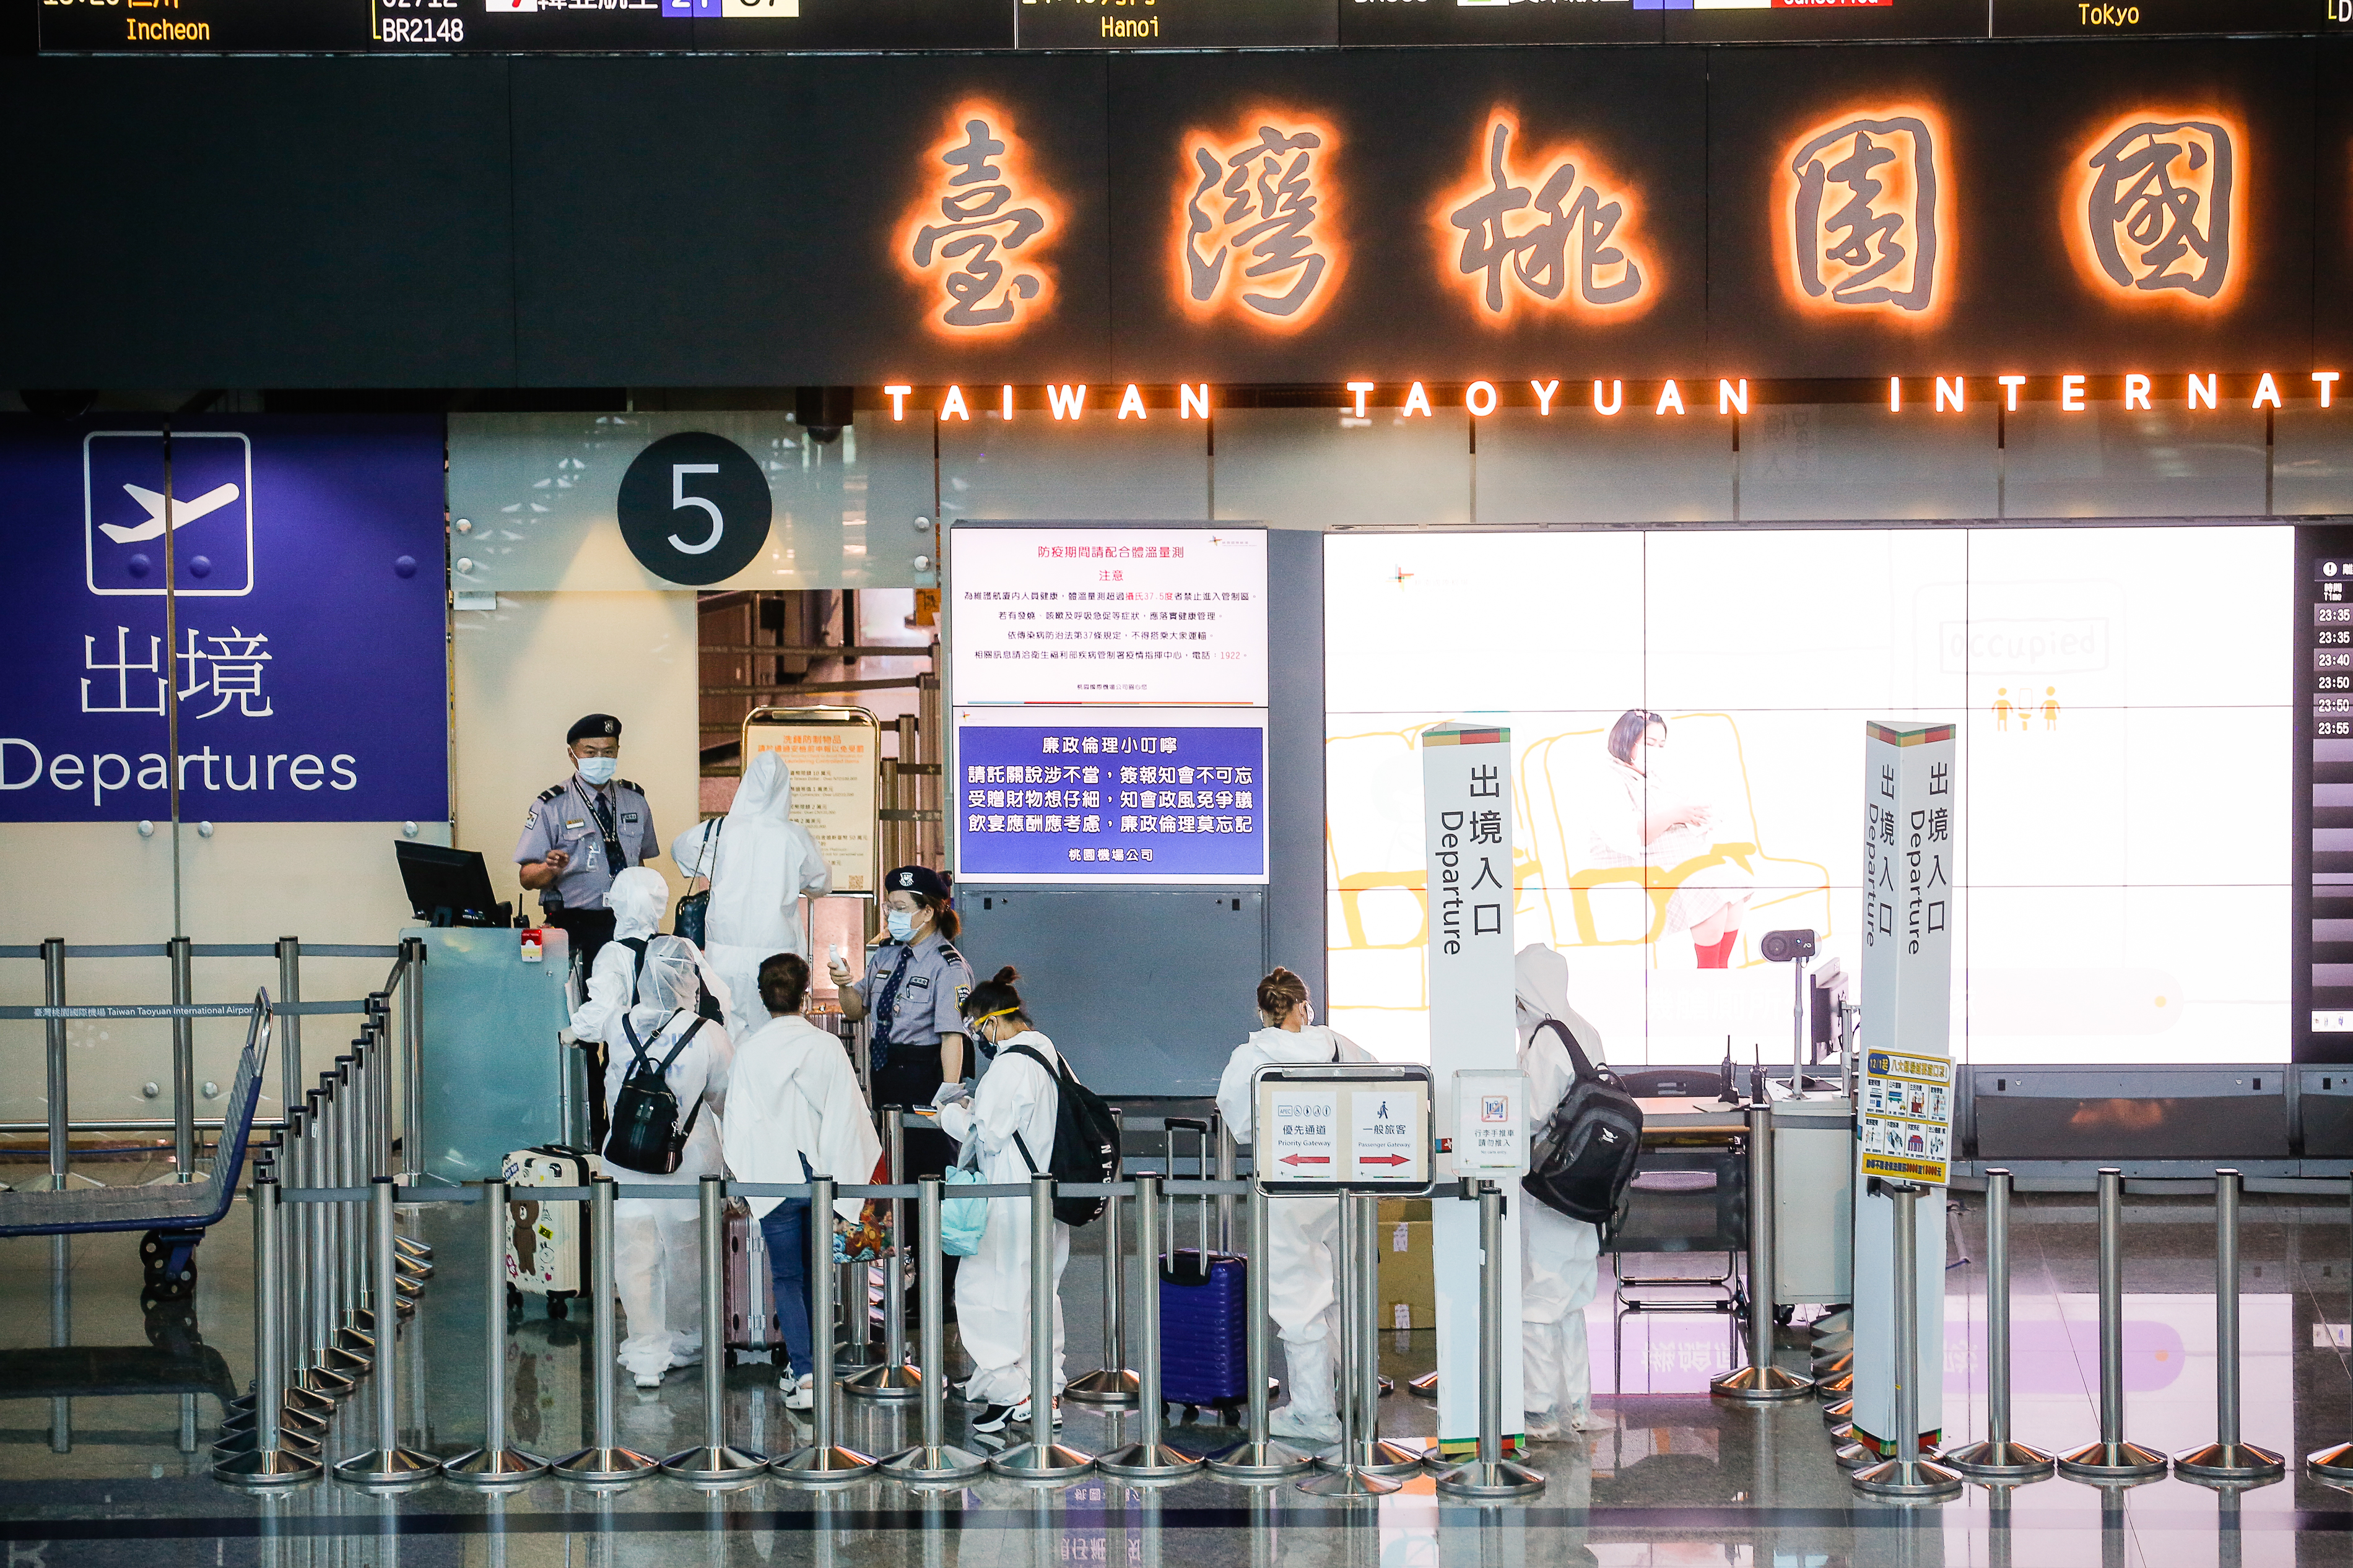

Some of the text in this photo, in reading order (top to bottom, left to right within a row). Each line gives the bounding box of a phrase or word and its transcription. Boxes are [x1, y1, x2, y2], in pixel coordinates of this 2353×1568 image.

[2079, 3, 2139, 26] Tokyo
[127, 19, 209, 40] Incheon
[383, 19, 463, 41] BR2148
[1102, 16, 1158, 37] Hanoi
[885, 373, 2339, 420] TAIWAN TAOYUAN INTERNAT
[668, 464, 723, 554] 5
[1038, 546, 1183, 558] 防疫期間請配合體溫量測
[1100, 570, 1123, 581] 注意
[2319, 609, 2351, 622] 23:35
[1950, 623, 2095, 664] occupied
[2319, 631, 2350, 644] 23:35
[2318, 653, 2350, 667] 23:40
[80, 626, 273, 719] 出境
[2318, 676, 2350, 689] 23:50
[2318, 698, 2350, 713] 23:50
[2318, 721, 2349, 735] 23:55
[1042, 736, 1178, 755] 廉政倫理小叮嚀
[0, 737, 358, 807] Departures
[967, 765, 1253, 785] 請託關說涉不當，簽報知會不可忘
[967, 790, 1253, 810] 受贈財物想仔細，知會政風免爭議
[967, 814, 1253, 834] 飲宴應酬應考慮，廉政倫理莫忘記
[1068, 848, 1154, 862] 桃園機場公司
[1469, 764, 1503, 935] 出境入口
[1879, 764, 1895, 937] 出境入口
[1927, 761, 1948, 934] 出境入口
[1435, 811, 1464, 955] Departure
[1866, 803, 1879, 947] Departure
[1907, 810, 1925, 955] Departure
[107, 1007, 136, 1016] Taiwan
[137, 1007, 172, 1018] Taoyuan
[173, 1006, 225, 1015] International
[226, 1005, 254, 1017] Airpor
[1284, 1125, 1325, 1135] 優先通道
[1364, 1125, 1406, 1134] 一般旅客
[1278, 1140, 1331, 1148] Priority Gateway
[1478, 1139, 1511, 1147] 請勿推入
